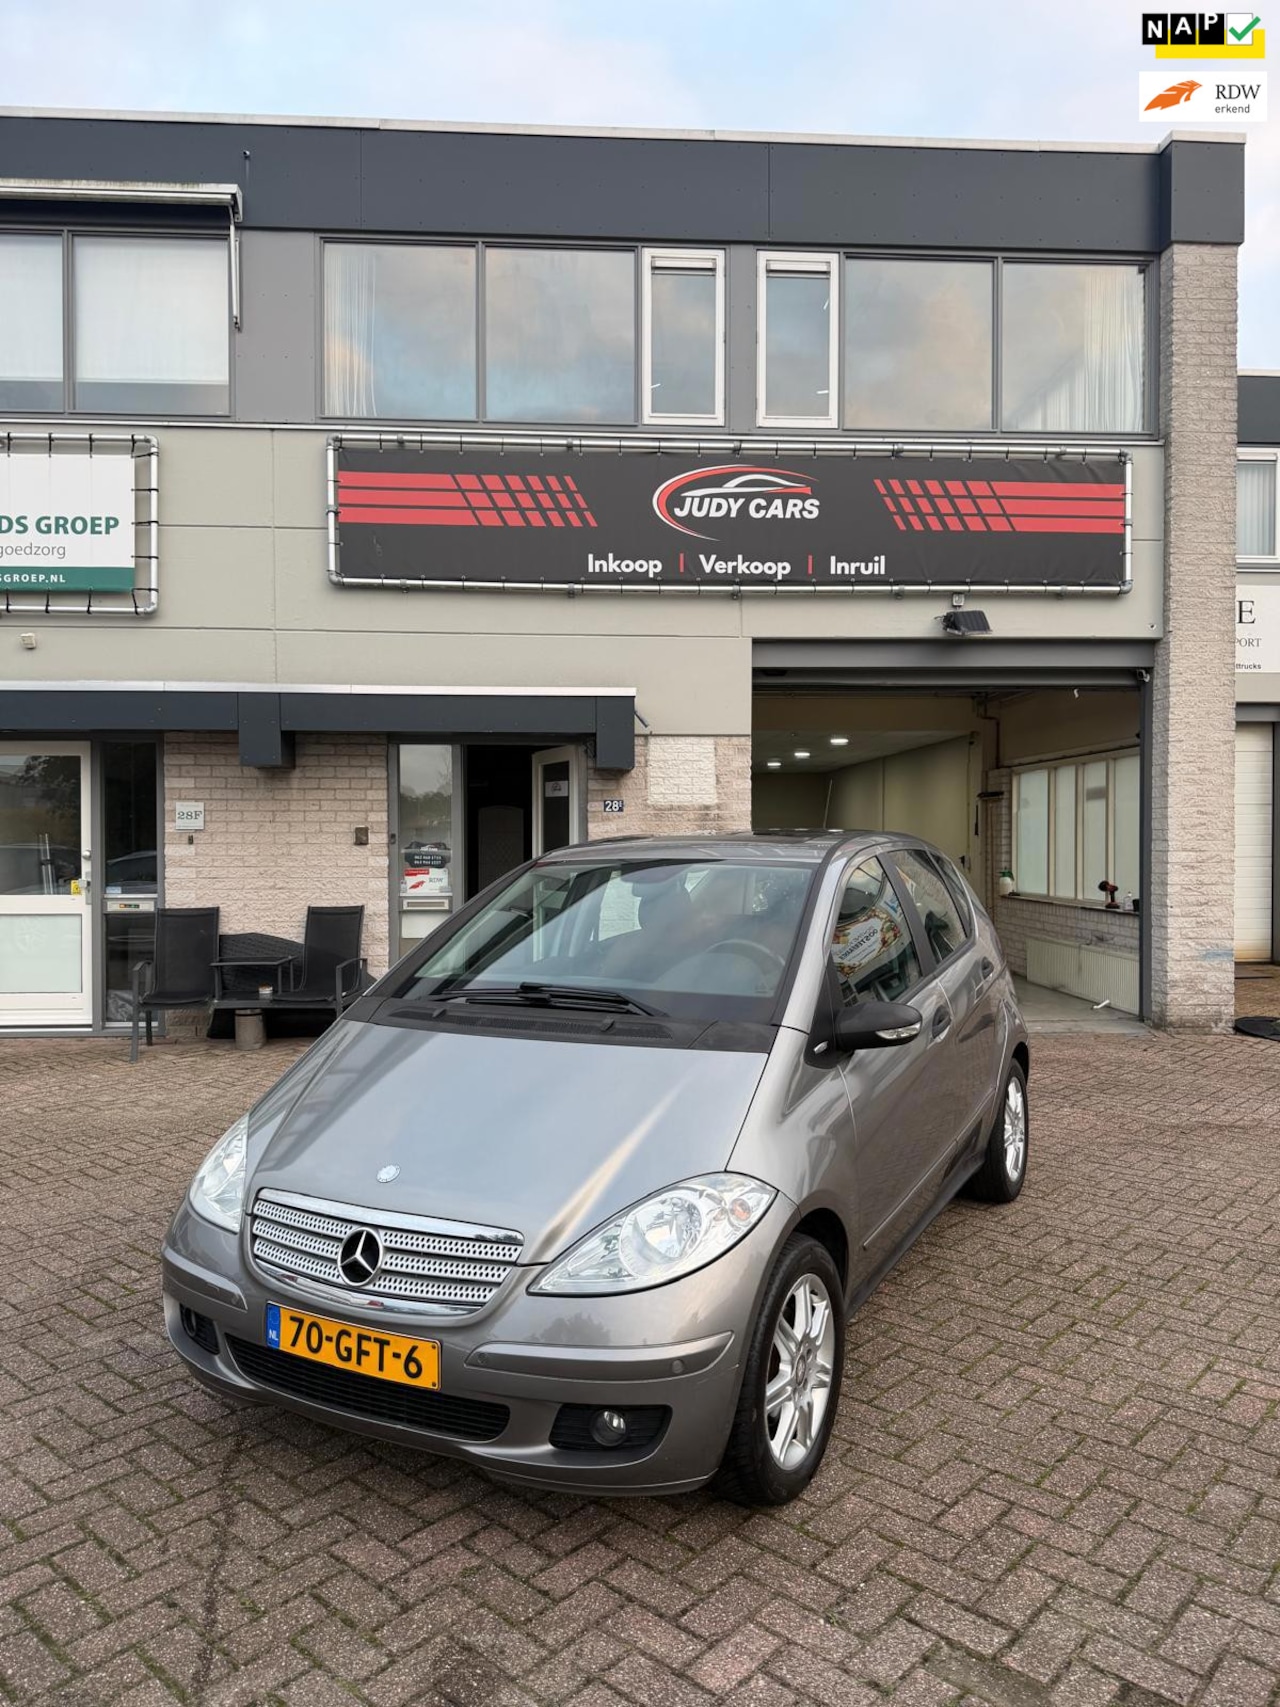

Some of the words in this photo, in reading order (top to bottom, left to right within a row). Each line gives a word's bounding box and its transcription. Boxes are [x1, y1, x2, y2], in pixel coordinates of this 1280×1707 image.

[673, 497, 745, 518] JUDY
[749, 498, 820, 519] CARS
[0, 515, 29, 534] DS
[35, 516, 119, 535] GROEP
[588, 553, 663, 578] Inkoop
[699, 554, 791, 580] Verkoop
[830, 555, 886, 575] Inruil
[0, 574, 66, 583] GROEP.NL
[1236, 600, 1256, 624] E
[177, 810, 203, 820] 28F
[268, 1329, 279, 1341] NL
[289, 1315, 423, 1379] 70-GFT-6
